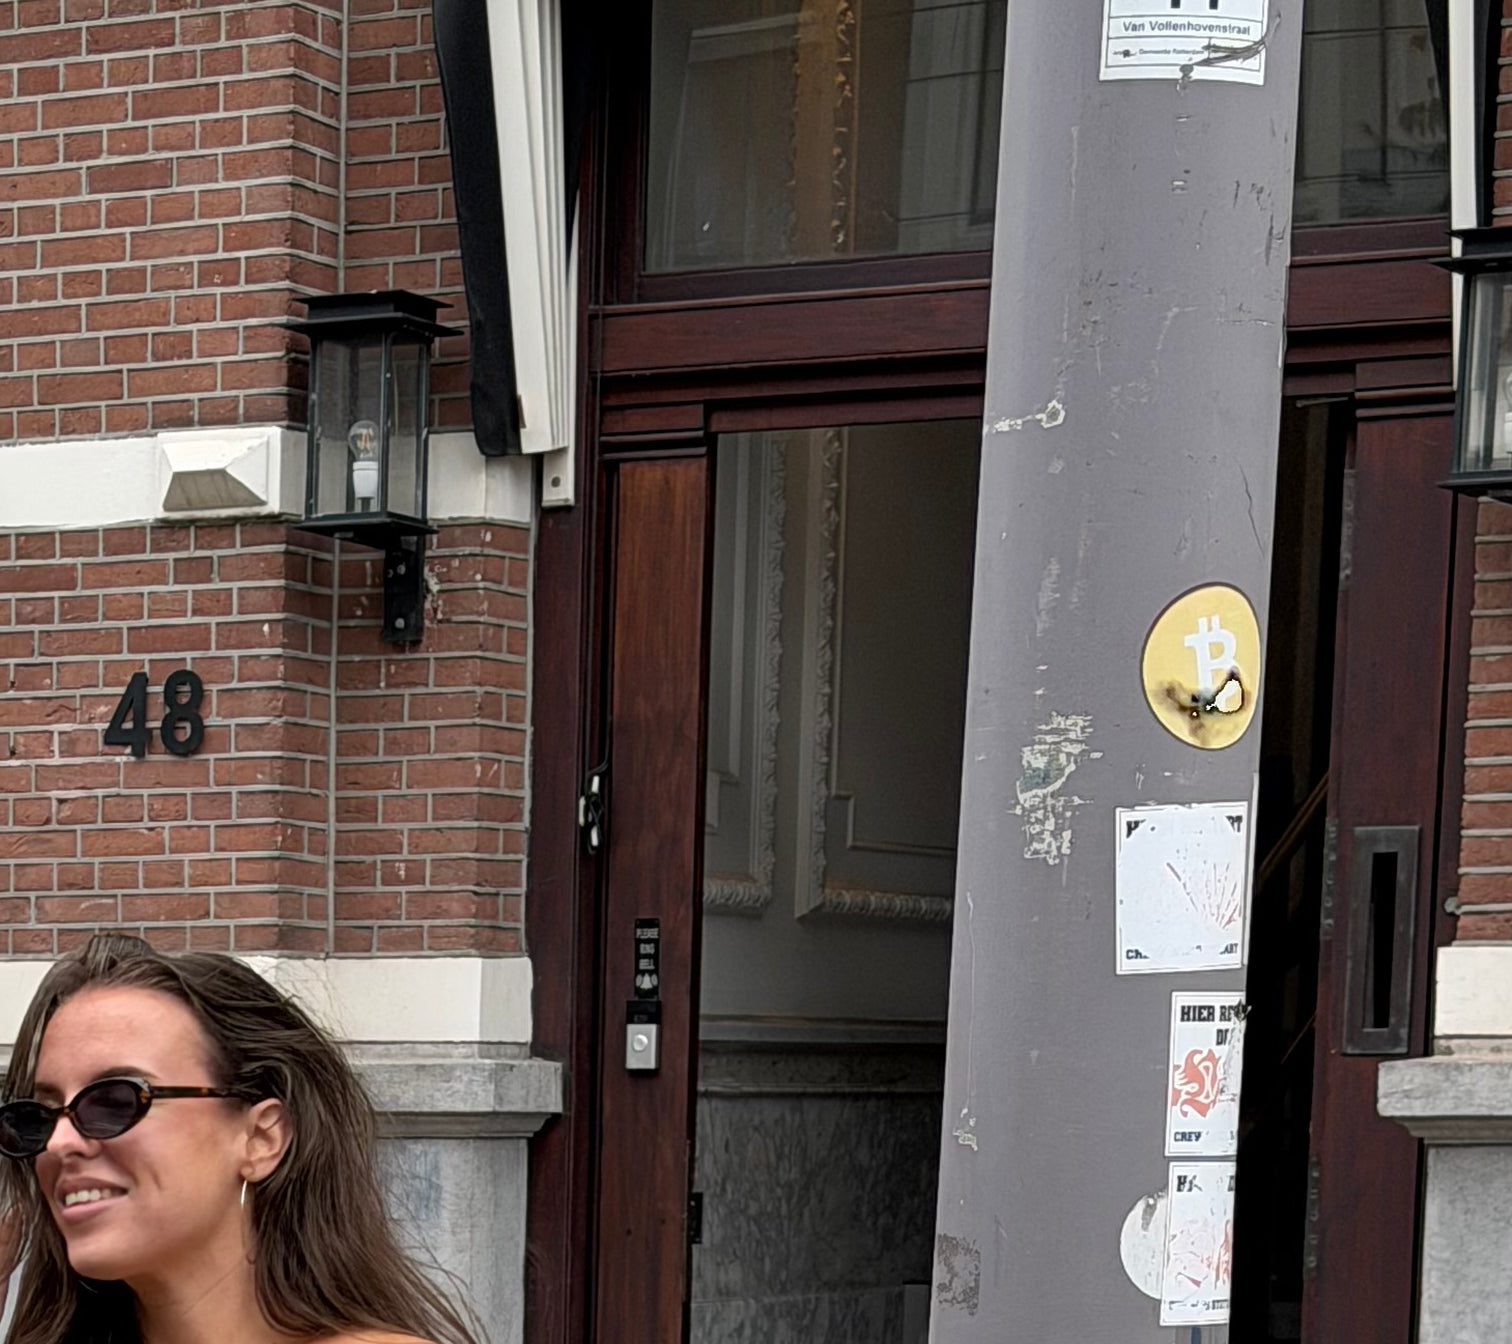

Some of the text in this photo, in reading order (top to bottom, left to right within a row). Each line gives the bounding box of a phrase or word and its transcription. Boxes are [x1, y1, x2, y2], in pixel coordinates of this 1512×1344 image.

[1123, 21, 1145, 32] Van
[104, 669, 204, 757] 48
[1180, 1005, 1216, 1022] HIER
